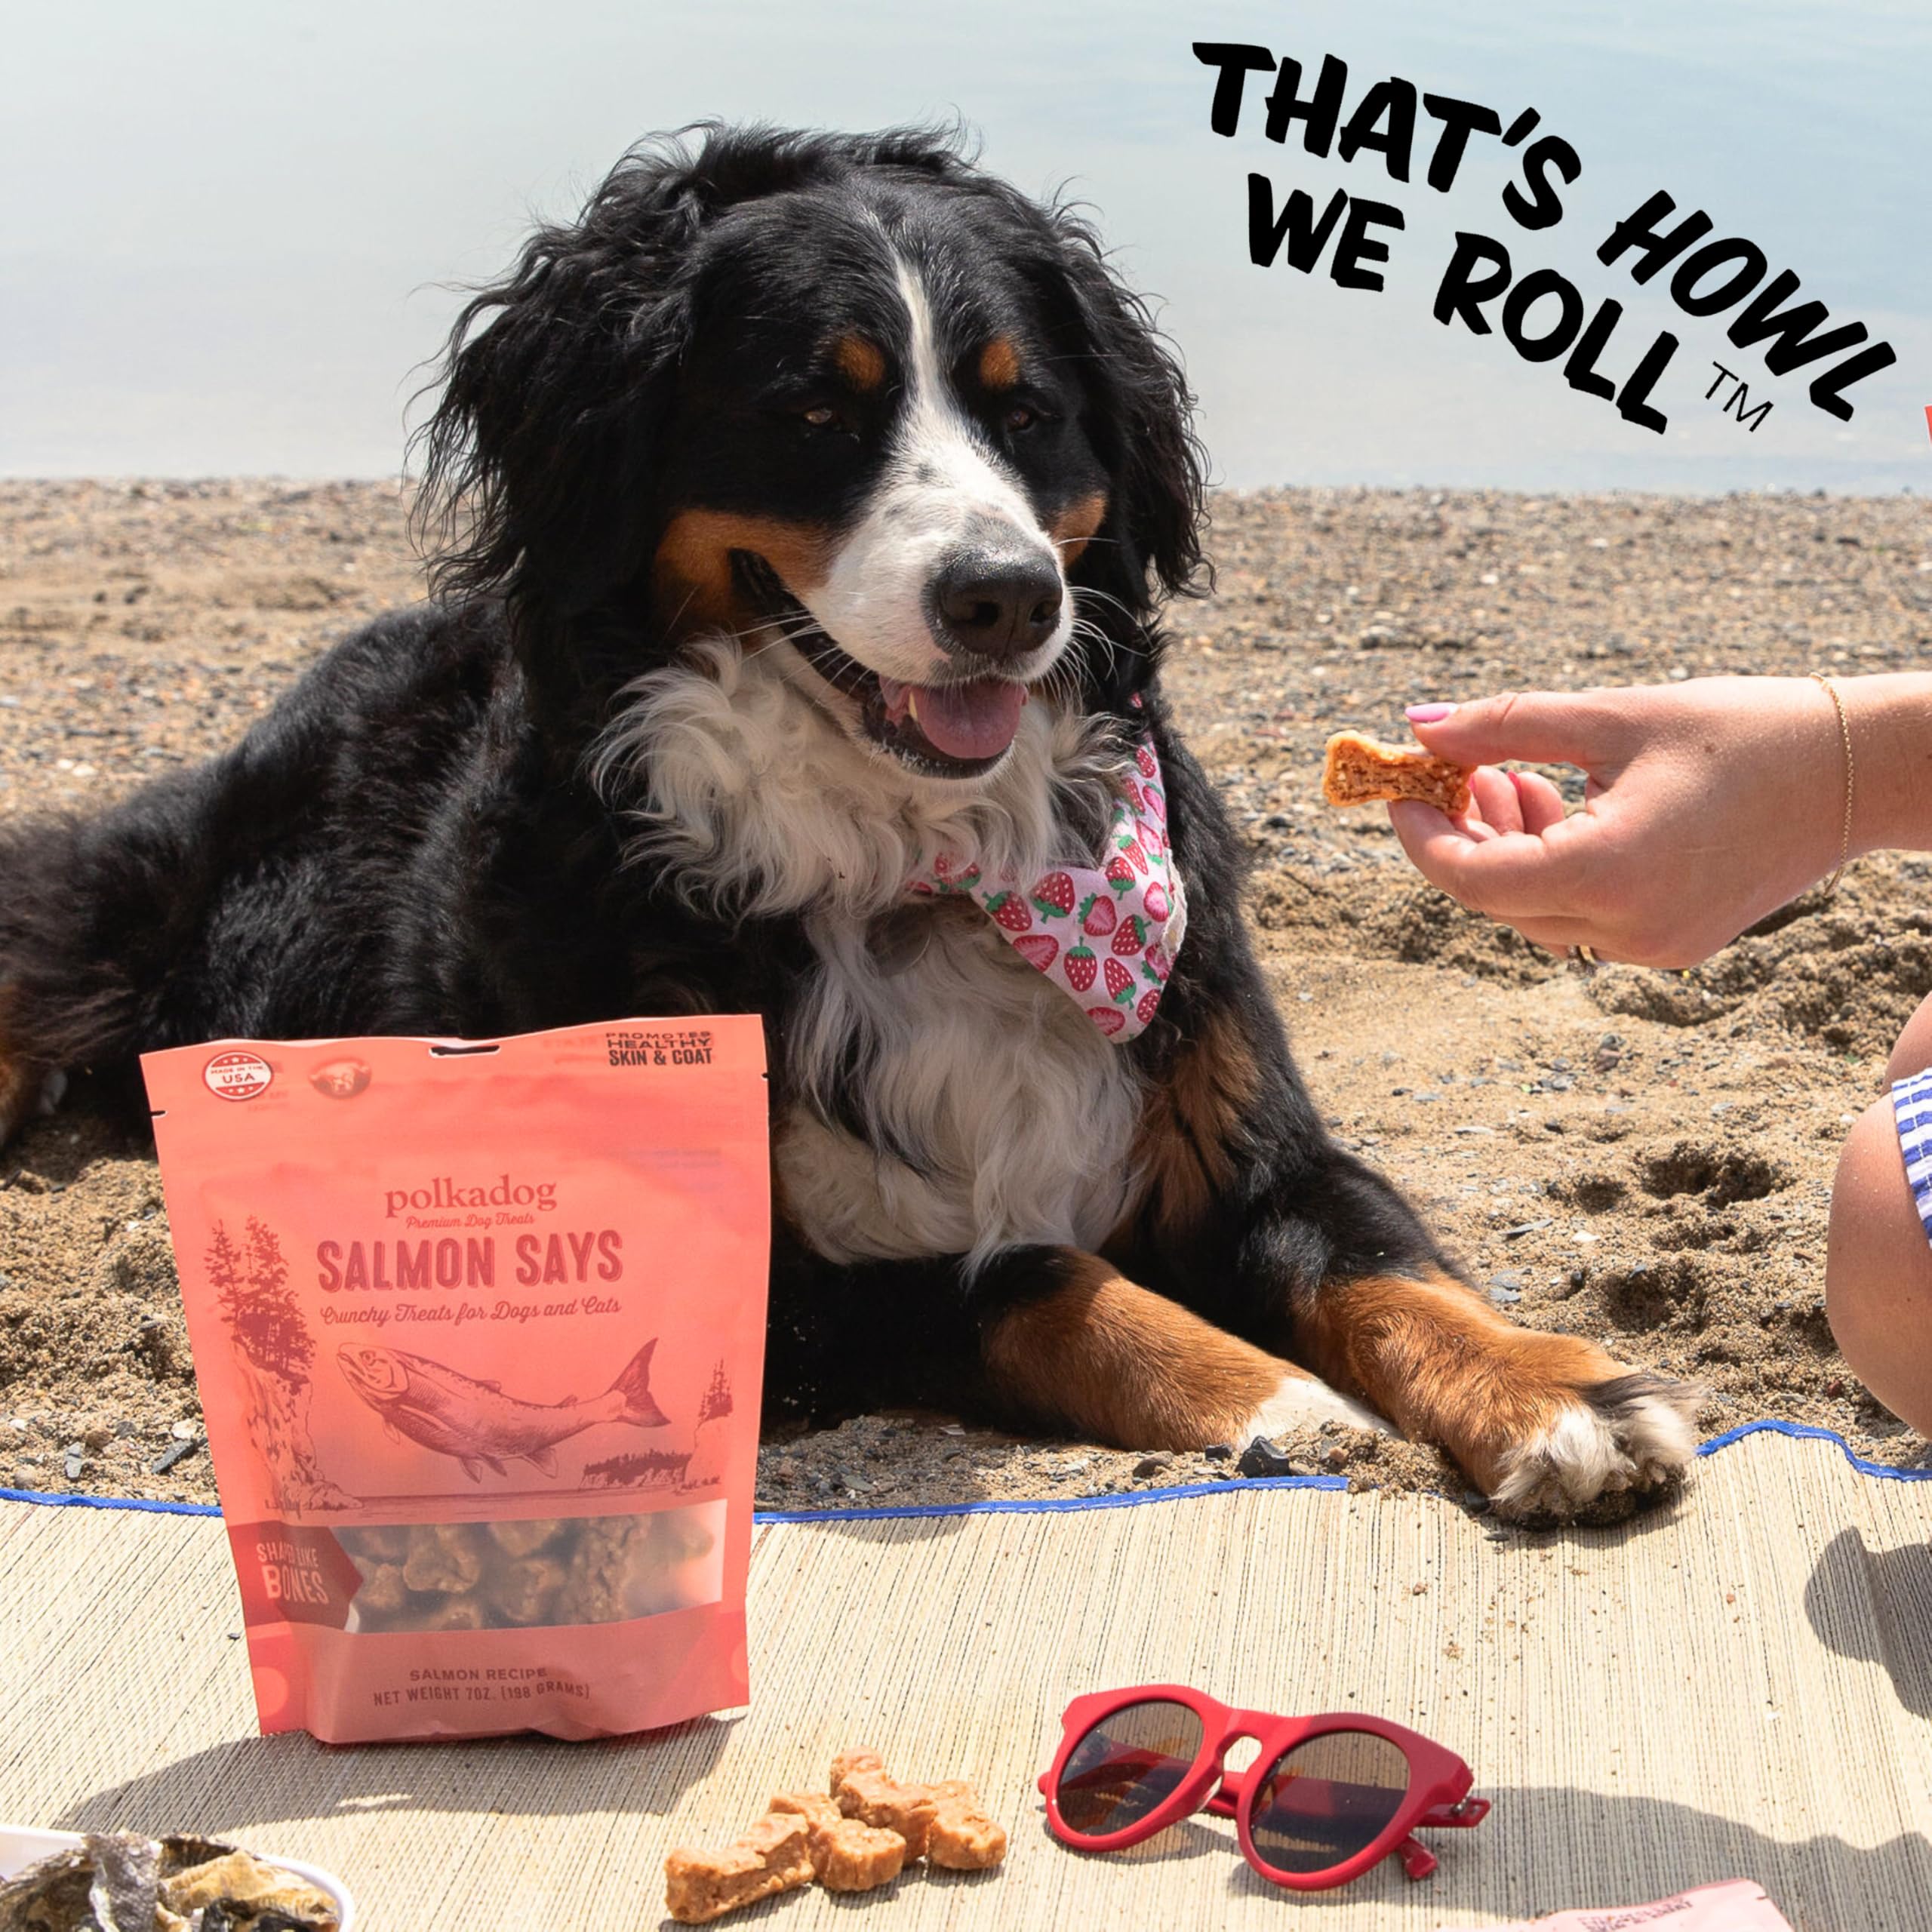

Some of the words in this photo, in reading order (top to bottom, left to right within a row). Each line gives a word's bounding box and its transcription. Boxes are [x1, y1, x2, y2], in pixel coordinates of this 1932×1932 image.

[605, 1031, 712, 1039] PROMOTES
[607, 1038, 712, 1049] HEALTHY
[608, 1048, 648, 1067] SKIN
[654, 1048, 667, 1066] &
[672, 1048, 712, 1066] COAT
[222, 1072, 256, 1084] USA
[384, 1174, 558, 1218] polkadog
[406, 1216, 462, 1229] Premium
[464, 1214, 493, 1229] Dog
[495, 1212, 536, 1226] Treats
[316, 1236, 495, 1293] SALMON
[515, 1229, 623, 1287] SAYS
[320, 1306, 391, 1327] Crunchy
[395, 1303, 454, 1322] Treats
[453, 1303, 488, 1326] for
[490, 1301, 540, 1324] Dogs
[543, 1299, 578, 1317] and
[580, 1296, 622, 1315] Cats
[261, 1564, 330, 1605] BONES
[409, 1667, 479, 1681] SALMON
[485, 1666, 548, 1681] RECIPE
[373, 1690, 400, 1706] NET
[406, 1686, 460, 1702] WEIGHT
[536, 1681, 591, 1700] GRAMS)
